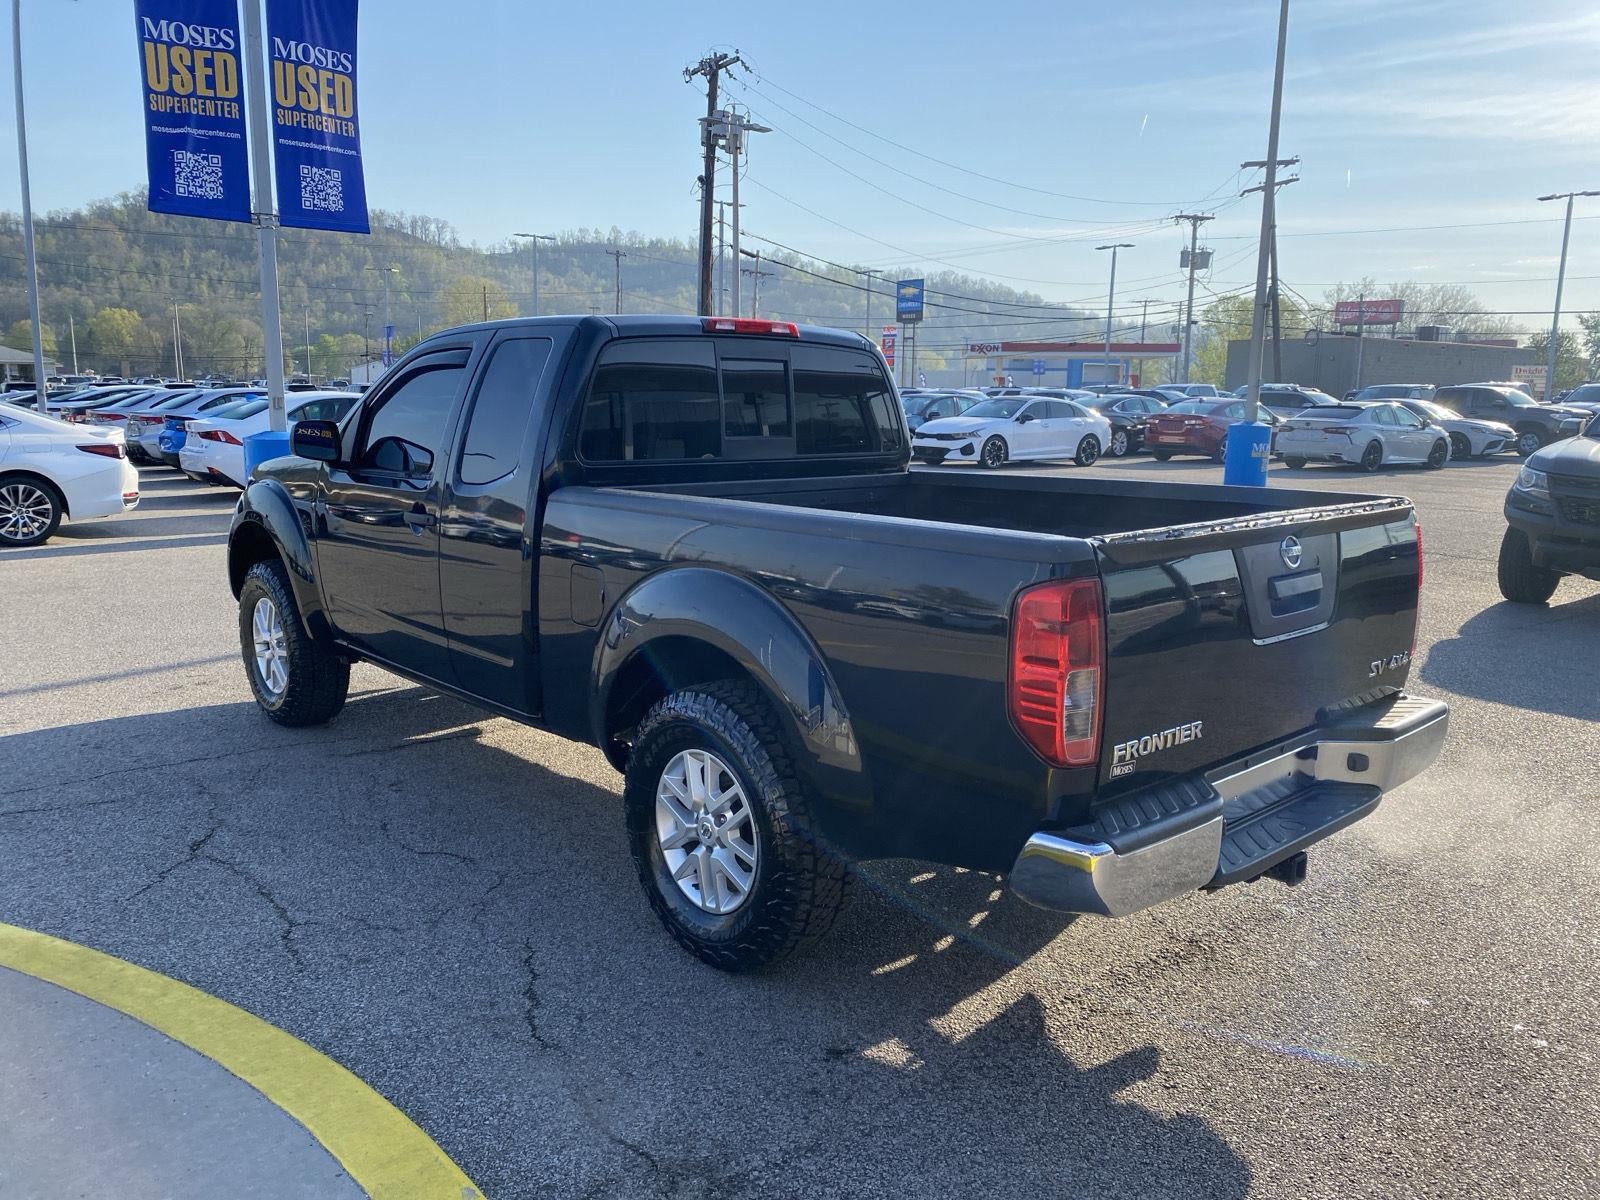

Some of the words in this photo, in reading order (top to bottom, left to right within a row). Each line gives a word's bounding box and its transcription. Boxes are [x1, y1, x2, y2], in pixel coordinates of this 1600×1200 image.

[142, 16, 235, 50] MOSES
[273, 36, 352, 74] MOSES
[144, 41, 239, 99] USED
[273, 60, 353, 118] USED
[149, 93, 240, 120] SUPERCENTER
[151, 125, 241, 139] mosesusedsupercenter.com
[277, 108, 355, 138] SUPERCENTER
[279, 138, 357, 156] mosesusedsupercenter.com
[970, 343, 1000, 355] EXXON
[1369, 658, 1387, 678] SV
[1113, 720, 1203, 765] FRONTIER
[1111, 764, 1134, 777] MOSES
